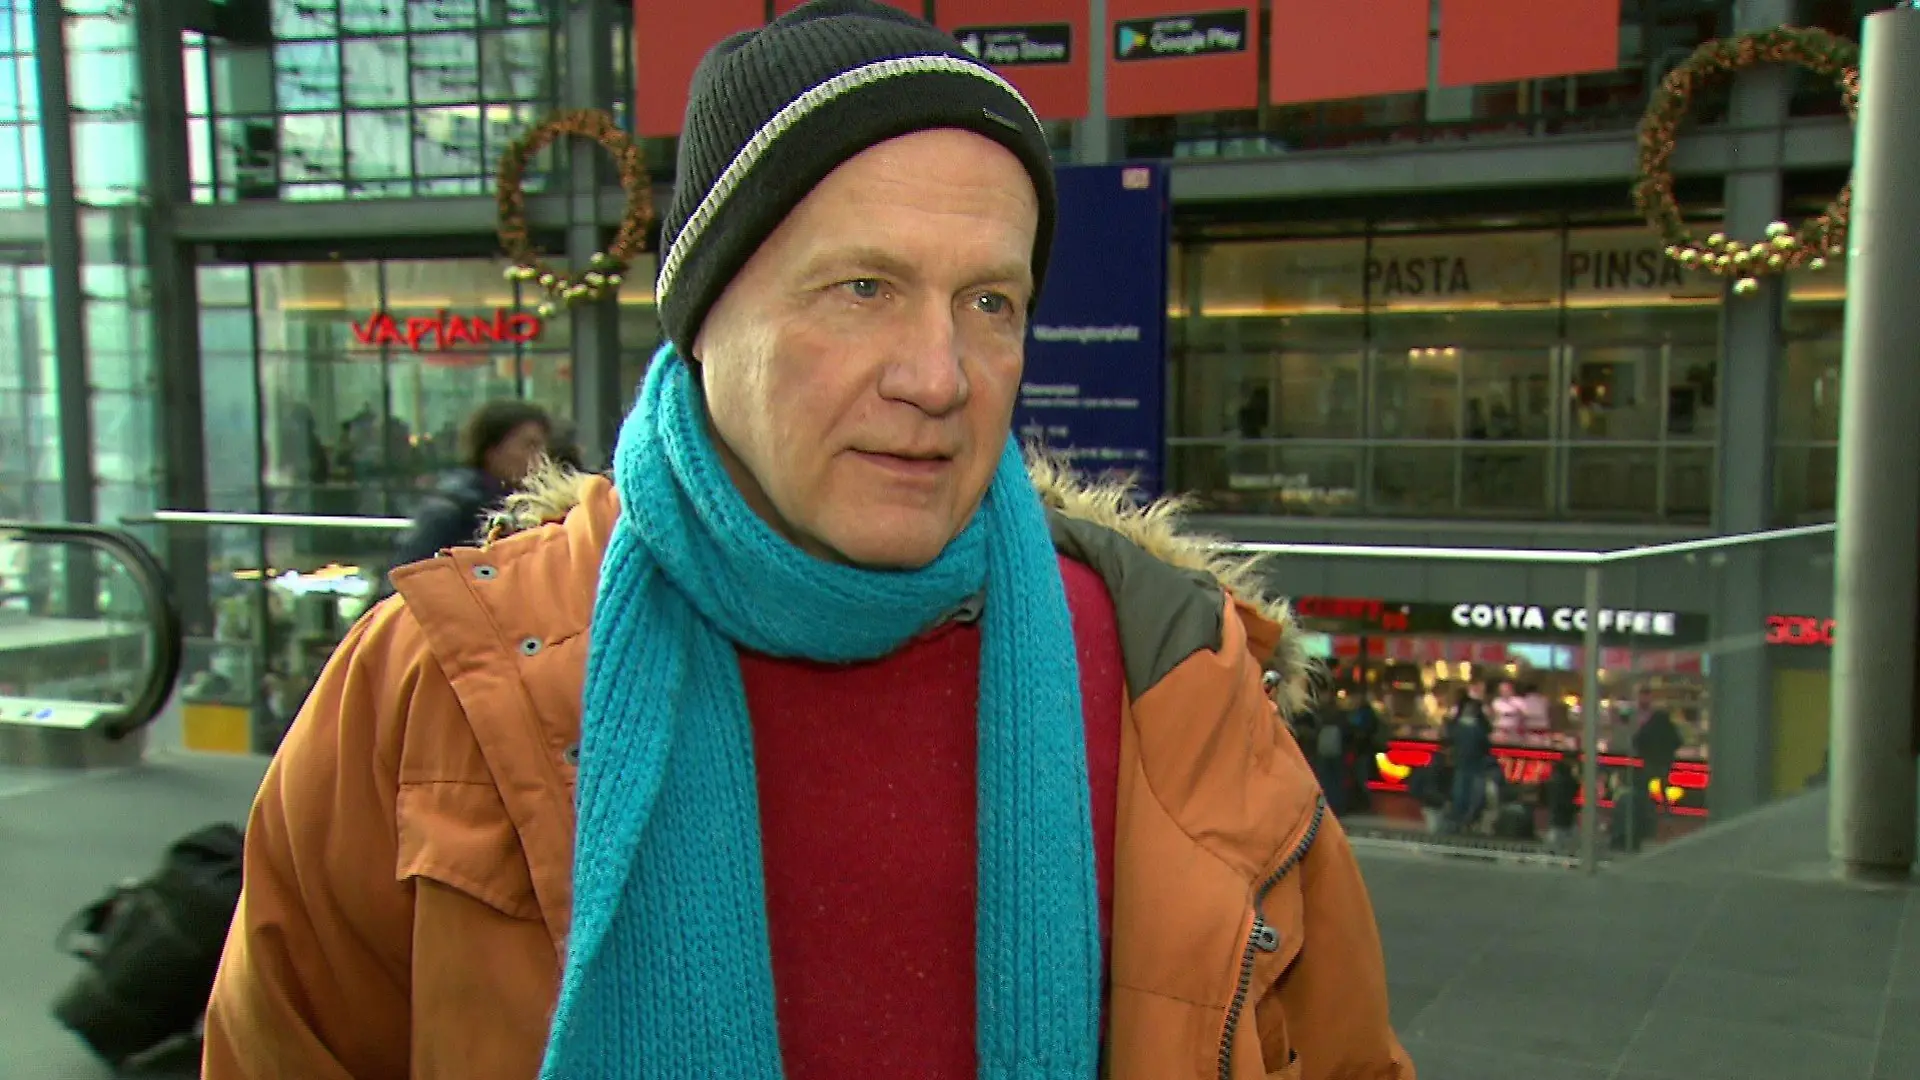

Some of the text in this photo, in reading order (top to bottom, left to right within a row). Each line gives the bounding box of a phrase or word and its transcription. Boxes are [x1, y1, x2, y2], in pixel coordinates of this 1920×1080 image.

[1150, 27, 1241, 54] Google Play
[1365, 256, 1470, 295] PASTA
[1567, 249, 1684, 288] PINSA
[351, 308, 541, 351] VAPIANO
[1451, 603, 1676, 636] COSTA COFFEE
